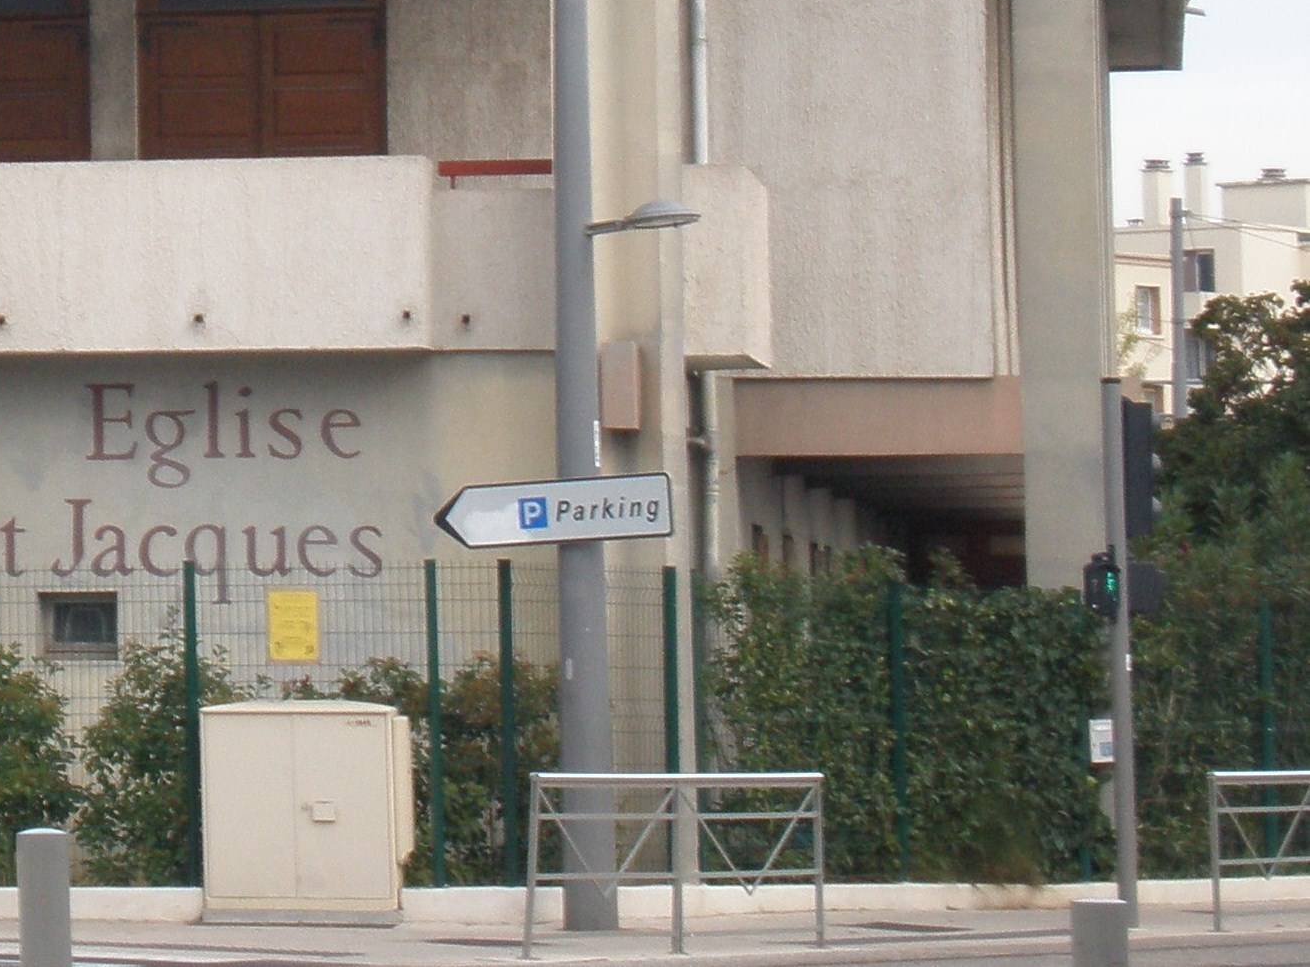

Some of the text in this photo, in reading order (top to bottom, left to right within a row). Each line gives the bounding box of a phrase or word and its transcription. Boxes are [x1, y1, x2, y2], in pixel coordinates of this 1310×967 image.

[86, 381, 361, 489] Eglise
[51, 498, 384, 605] Jacques
[523, 496, 660, 526] P Parking
